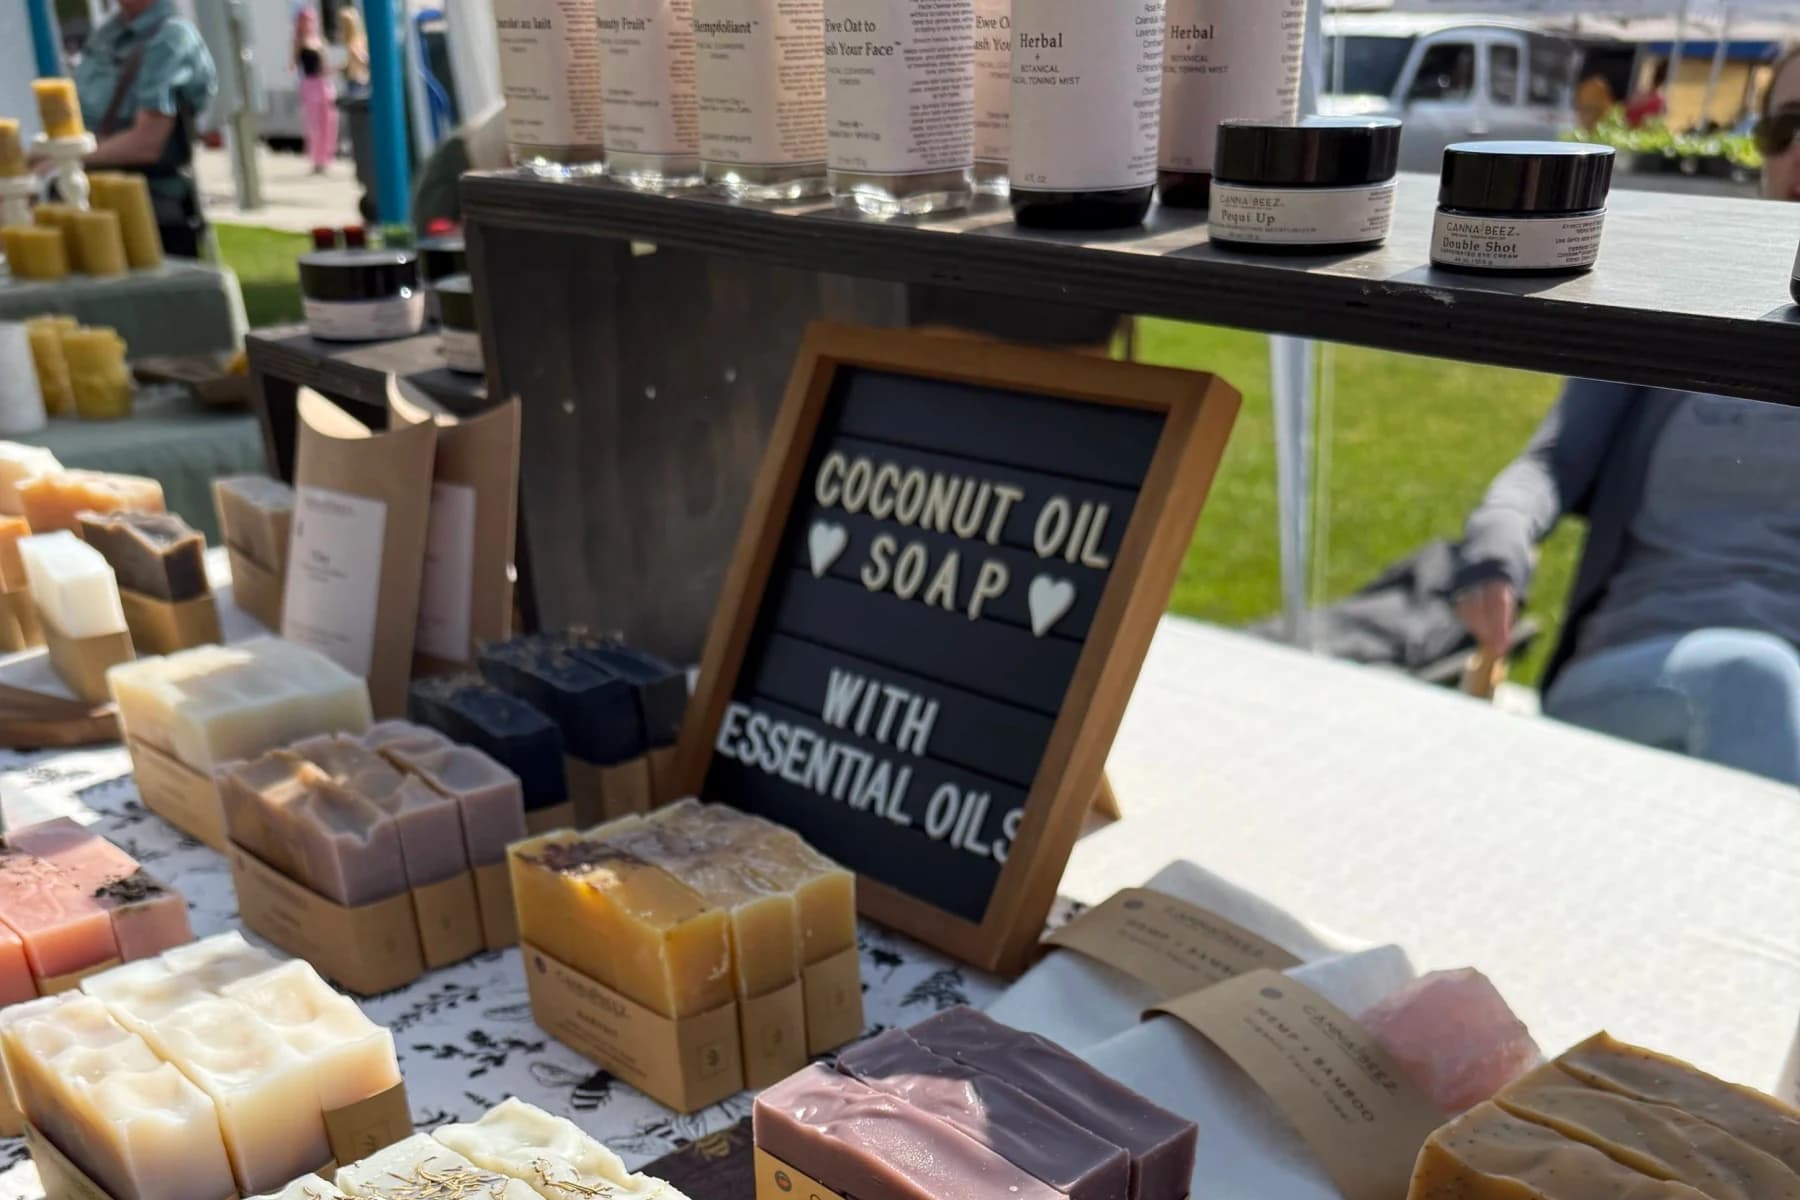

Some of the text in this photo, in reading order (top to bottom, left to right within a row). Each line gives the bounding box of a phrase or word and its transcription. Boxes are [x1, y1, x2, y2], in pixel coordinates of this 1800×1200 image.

[1020, 33, 1063, 48] Herbal
[1170, 25, 1214, 39] Herbal
[1058, 76, 1080, 86] MIST
[1256, 212, 1276, 227] Up
[1442, 236, 1517, 253] Double Shot
[814, 451, 1111, 569] COCONUT OIL
[860, 533, 1011, 621] SOAP
[821, 667, 940, 756] WITH
[714, 704, 1027, 864] ESSENTIAL OILS
[1312, 1056, 1375, 1122] BAMBOO
